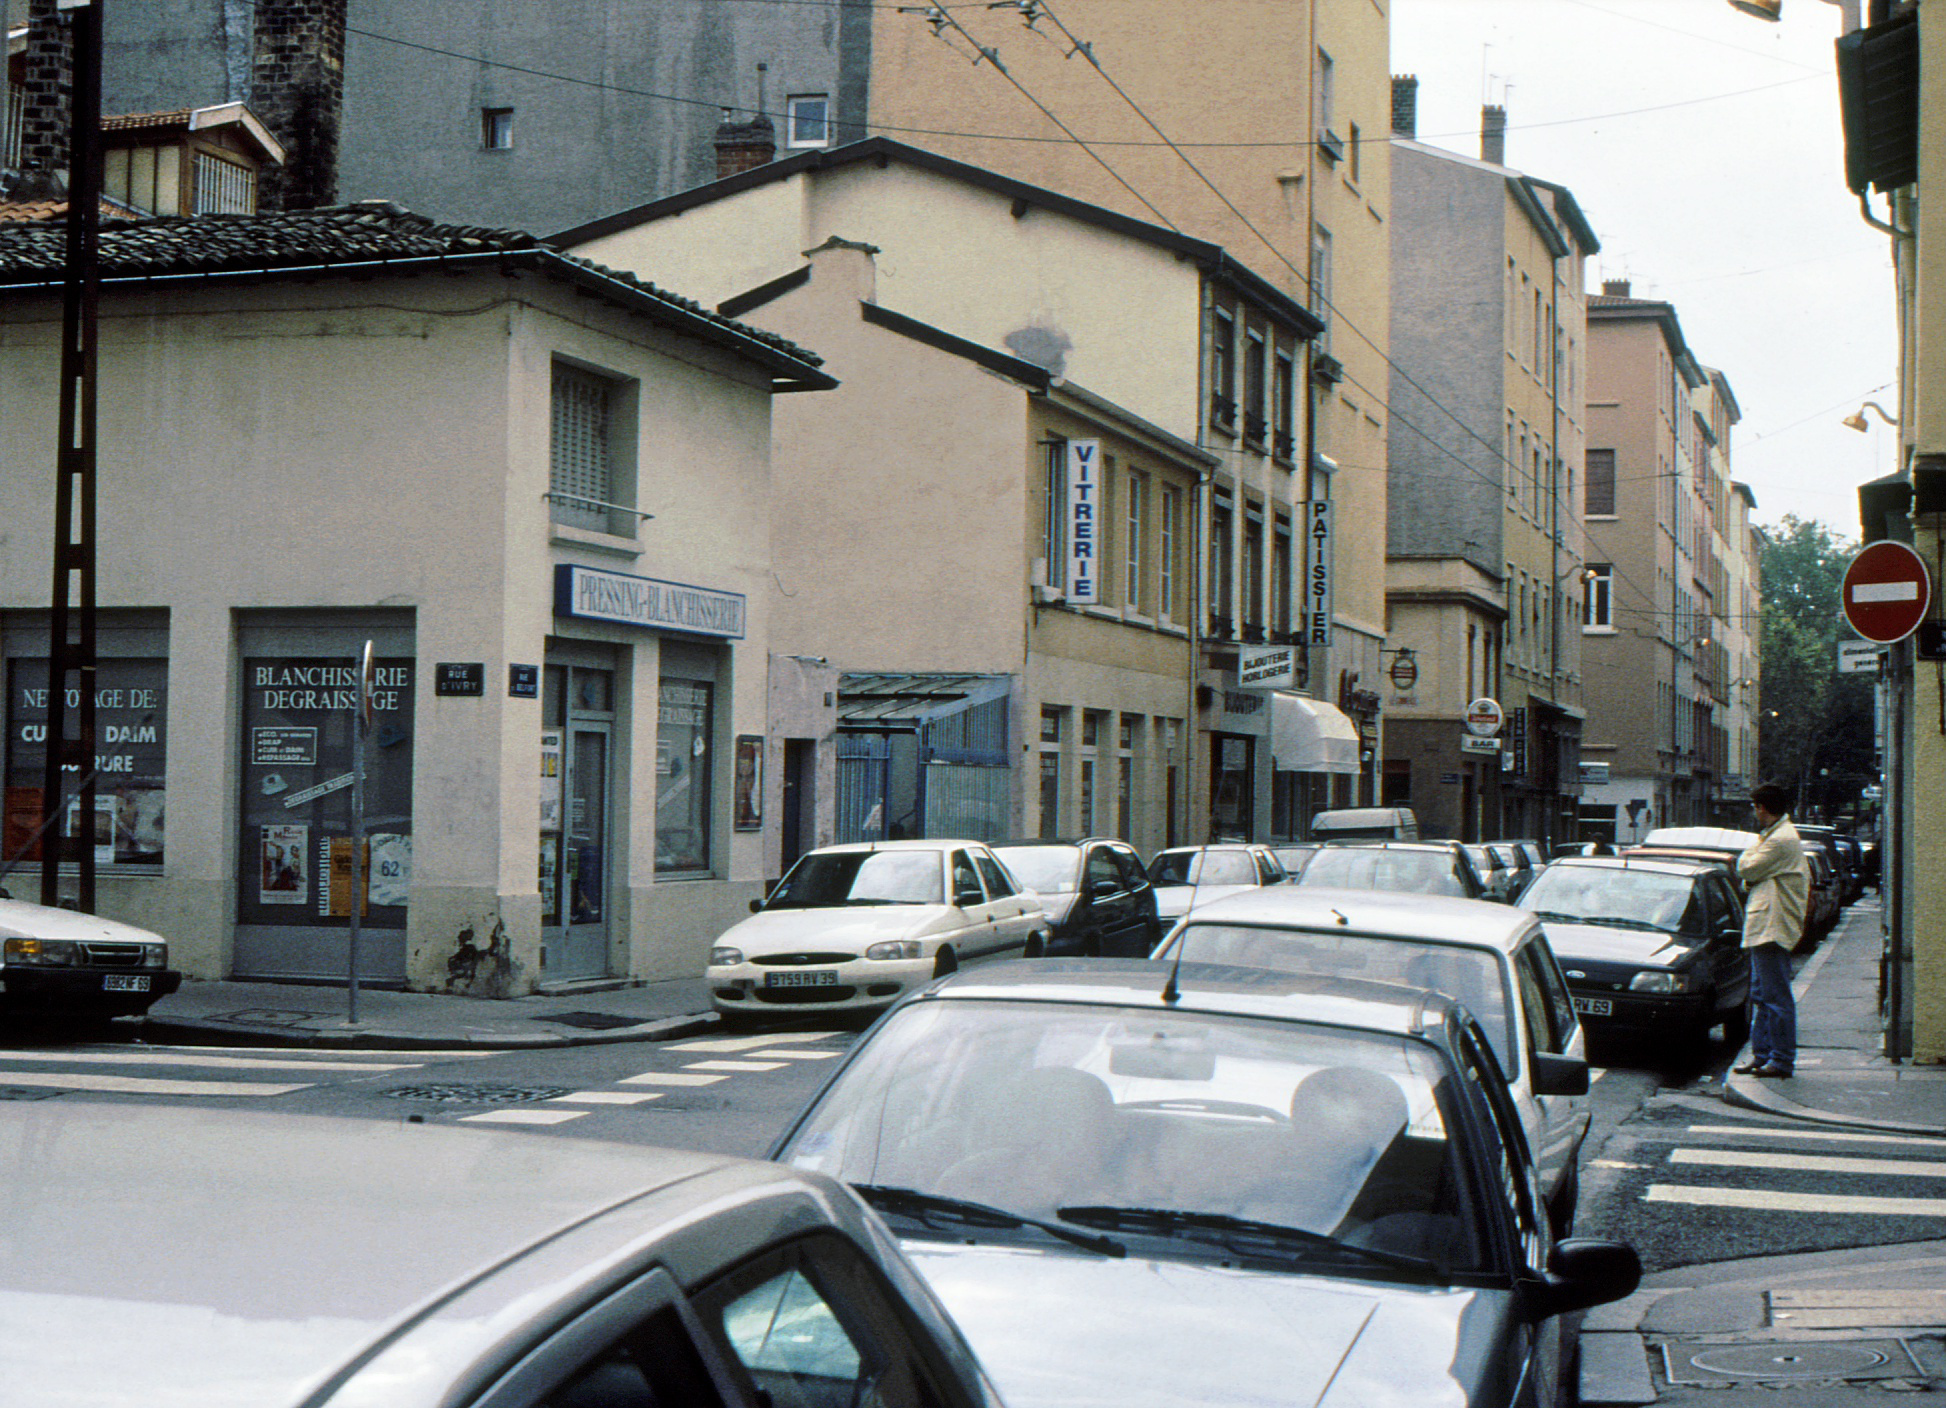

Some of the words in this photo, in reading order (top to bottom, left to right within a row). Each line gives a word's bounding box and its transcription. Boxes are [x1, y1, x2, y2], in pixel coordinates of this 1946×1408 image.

[1075, 446, 1094, 596] VITRERIE
[1312, 503, 1327, 643] PATISSIER
[1243, 650, 1292, 671] BIJOUTERIE
[256, 667, 408, 687] BLANCHISSRIE
[448, 670, 468, 679] RUE
[1241, 663, 1292, 684] HORLOGERIE
[264, 690, 399, 710] DEGRAISSGE
[105, 725, 156, 743] DAIM
[381, 860, 399, 877] 62
[1593, 1000, 1609, 1013] 69
